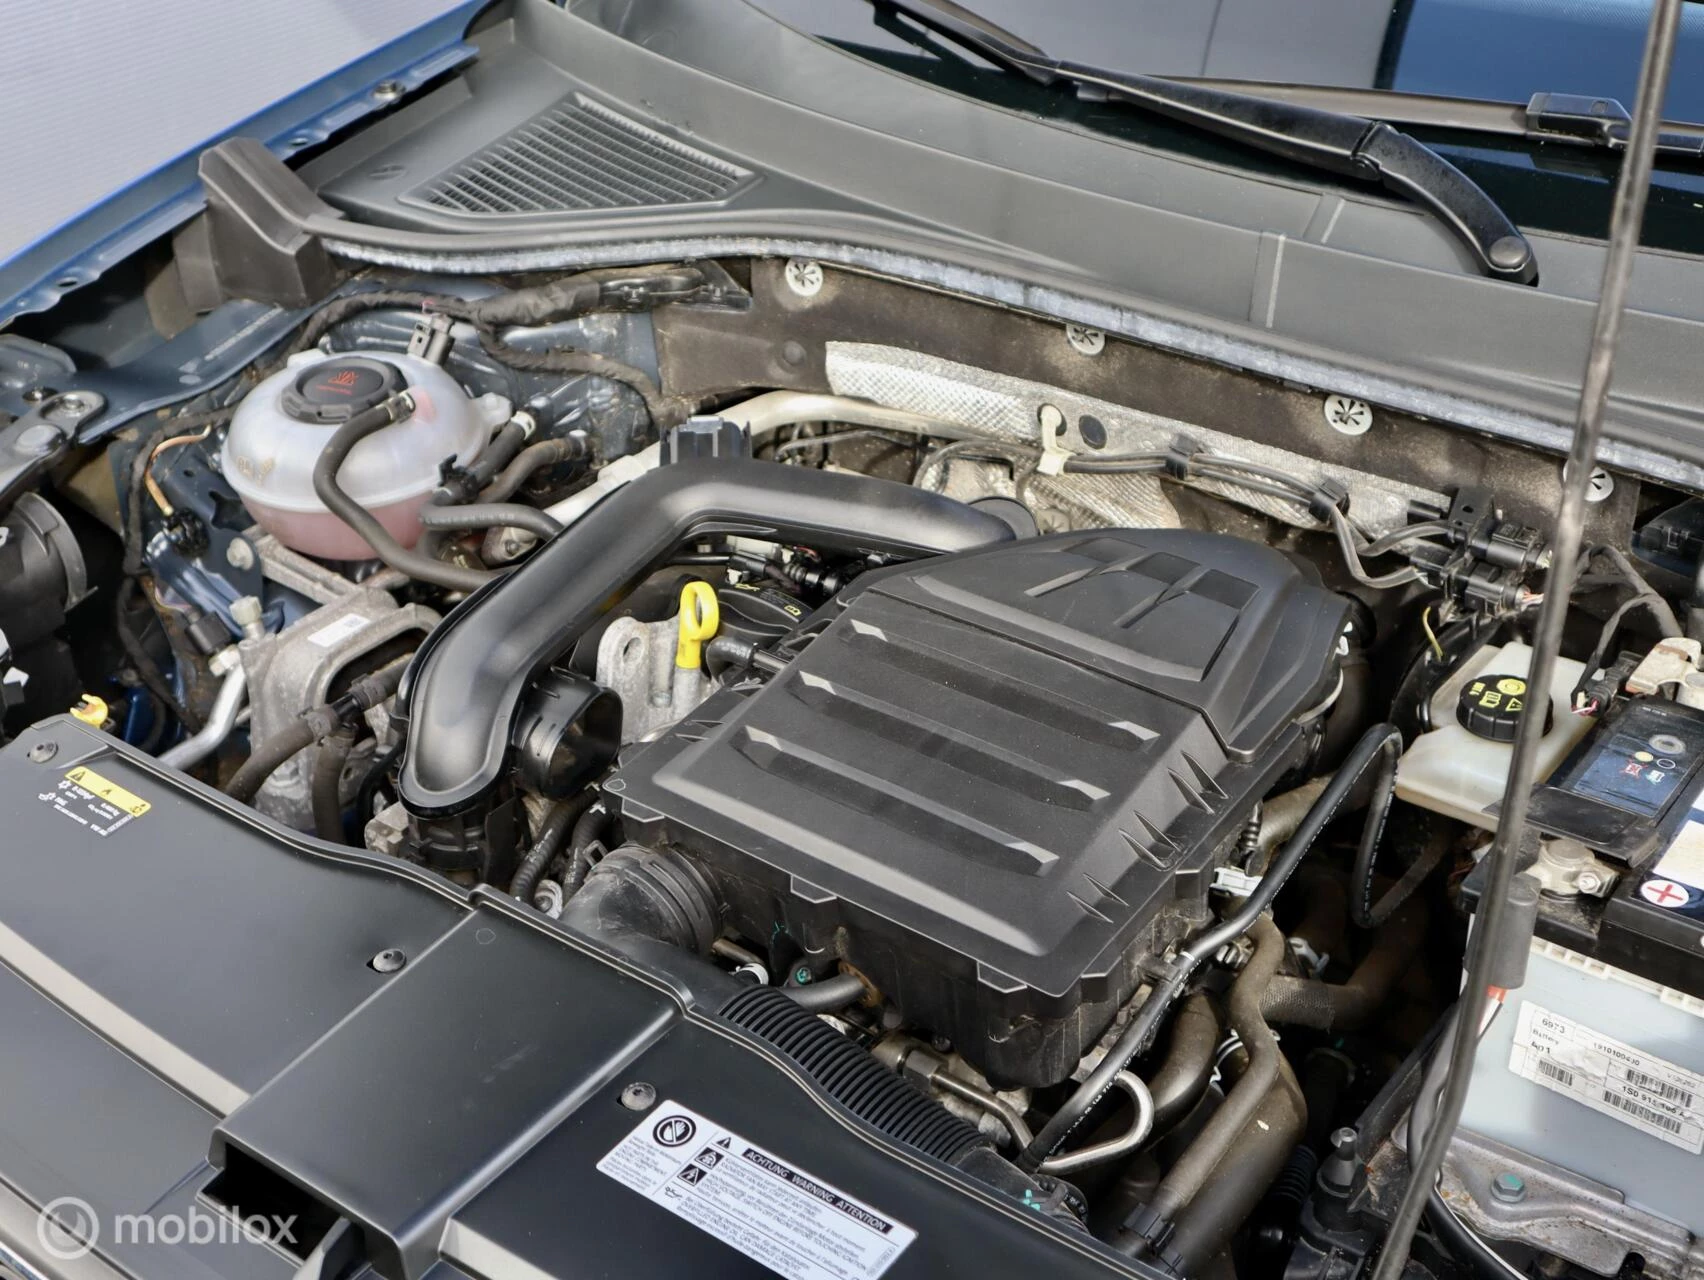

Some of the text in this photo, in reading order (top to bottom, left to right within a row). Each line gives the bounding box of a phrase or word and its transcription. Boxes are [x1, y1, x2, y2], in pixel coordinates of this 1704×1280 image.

[744, 1150, 888, 1230] ACHTUNG WARNING ATTENTION
